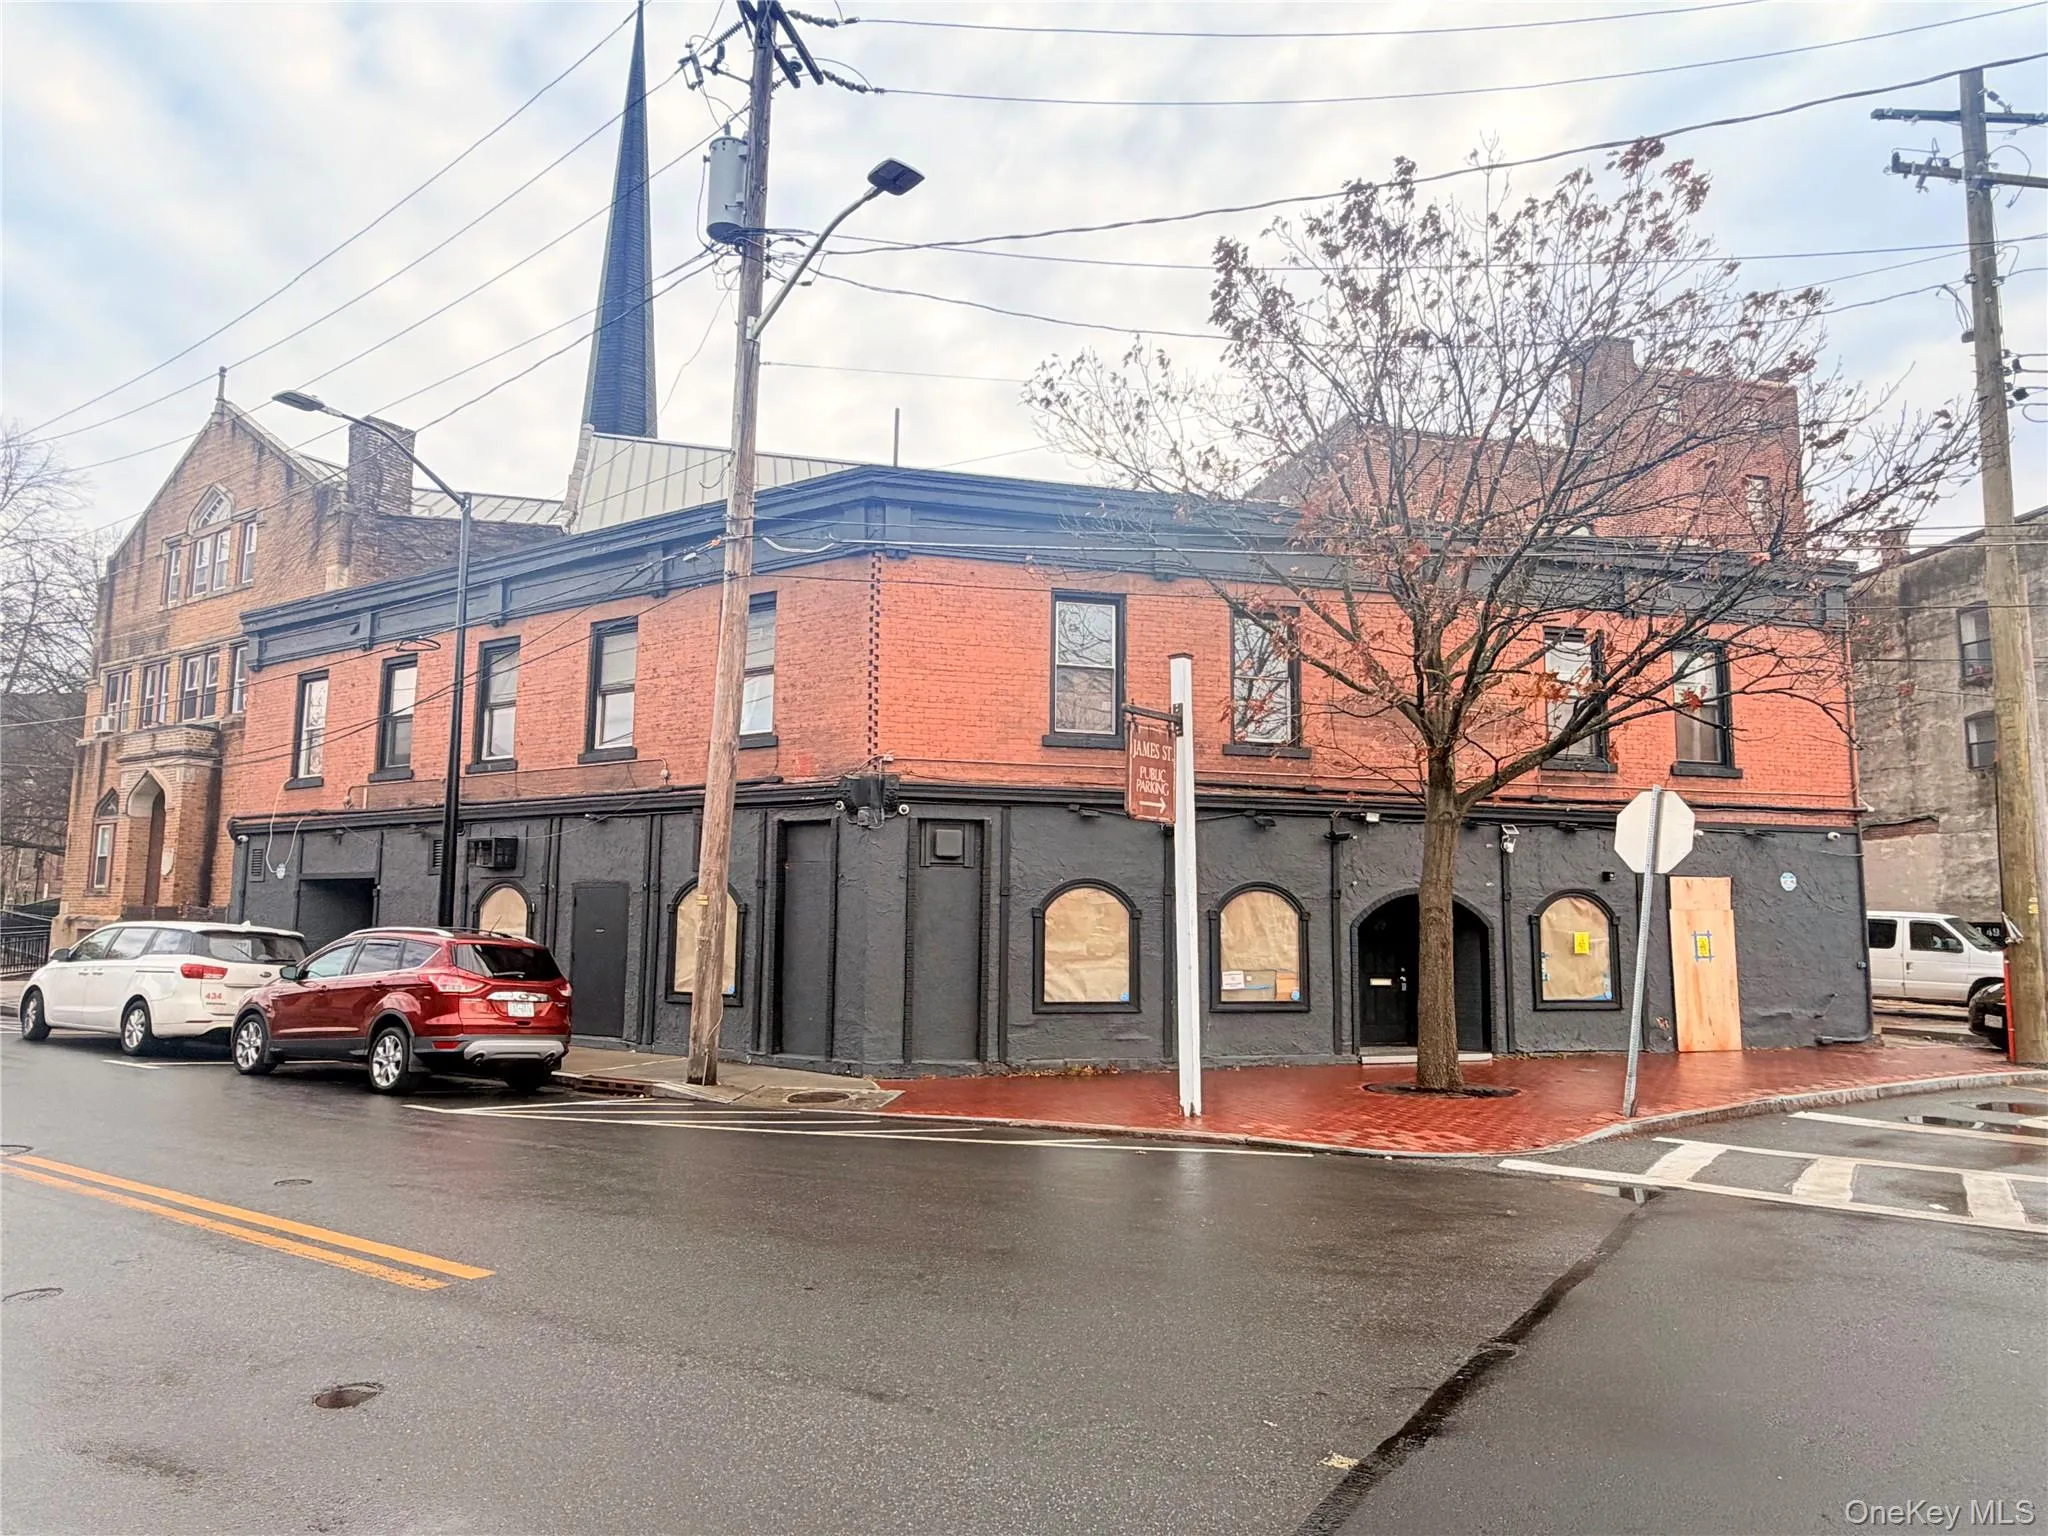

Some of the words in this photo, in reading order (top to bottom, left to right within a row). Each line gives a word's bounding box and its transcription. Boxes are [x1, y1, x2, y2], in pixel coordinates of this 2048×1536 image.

[1132, 739, 1160, 759] JAMES
[1140, 766, 1166, 782] PUBLIC
[1136, 779, 1169, 796] PARKING
